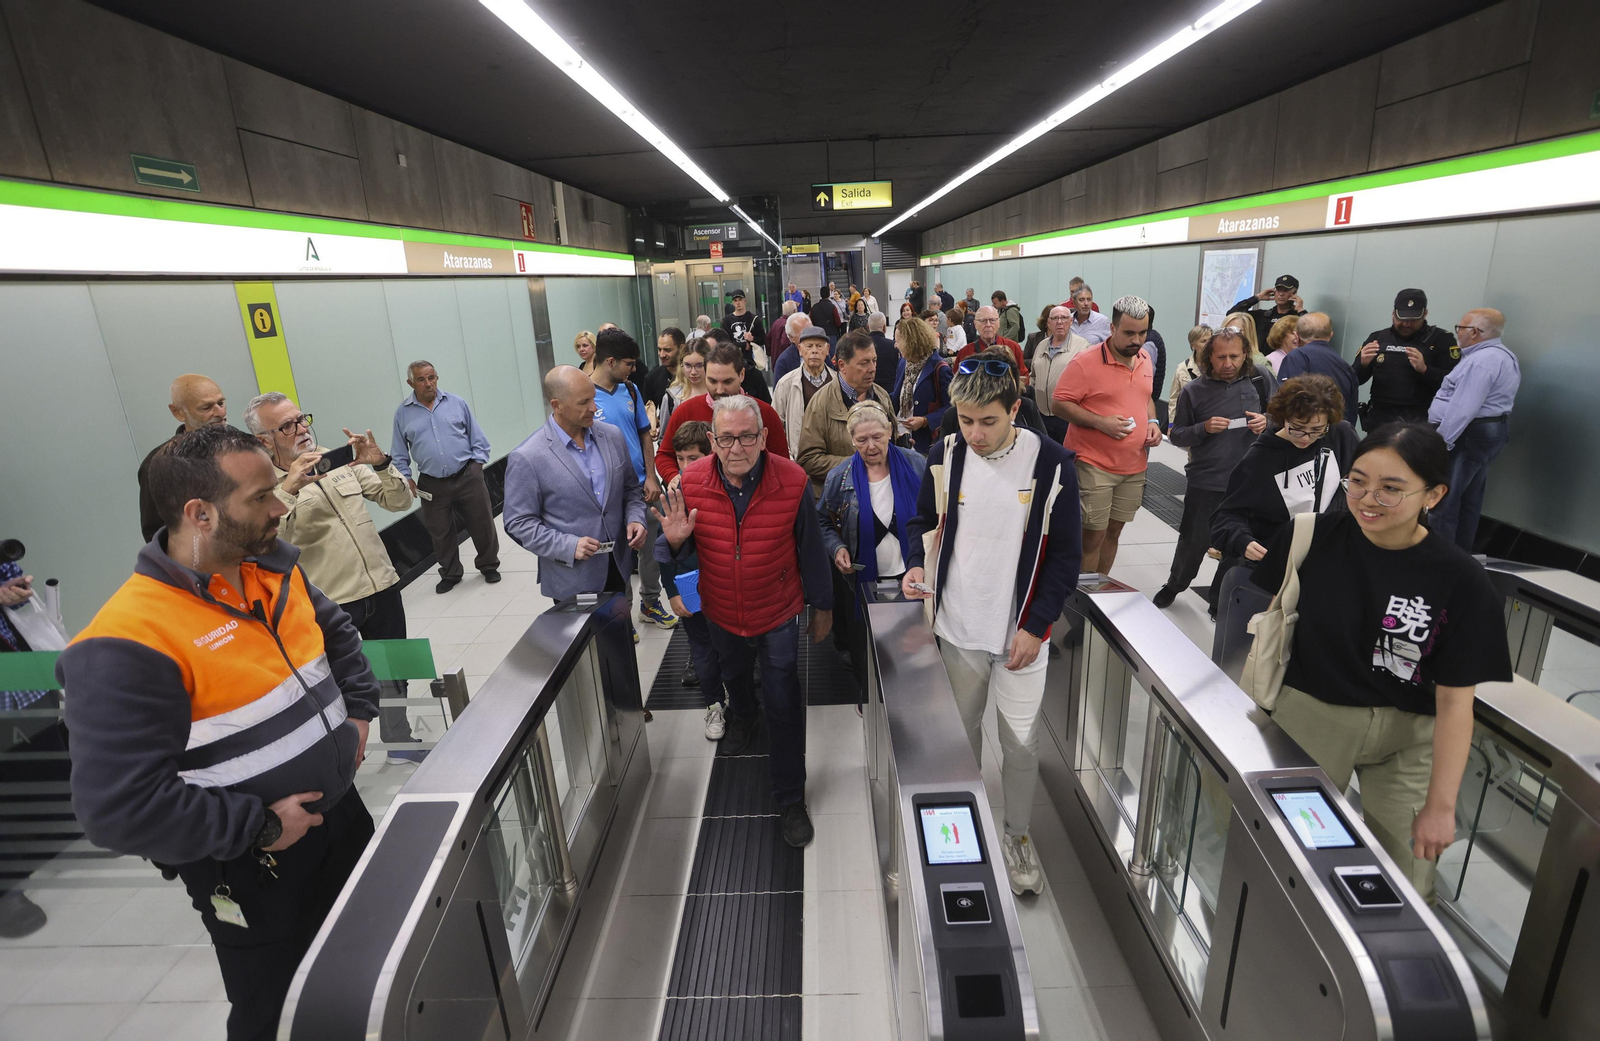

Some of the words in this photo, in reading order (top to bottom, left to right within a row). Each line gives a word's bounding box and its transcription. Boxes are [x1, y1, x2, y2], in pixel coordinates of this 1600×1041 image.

[841, 188, 871, 198] Salida
[1338, 199, 1347, 222] 1
[693, 228, 721, 236] Ascensor
[1217, 216, 1280, 234] Atarazanas
[443, 251, 493, 269] Atarazanas
[193, 620, 239, 647] SGURIDAD
